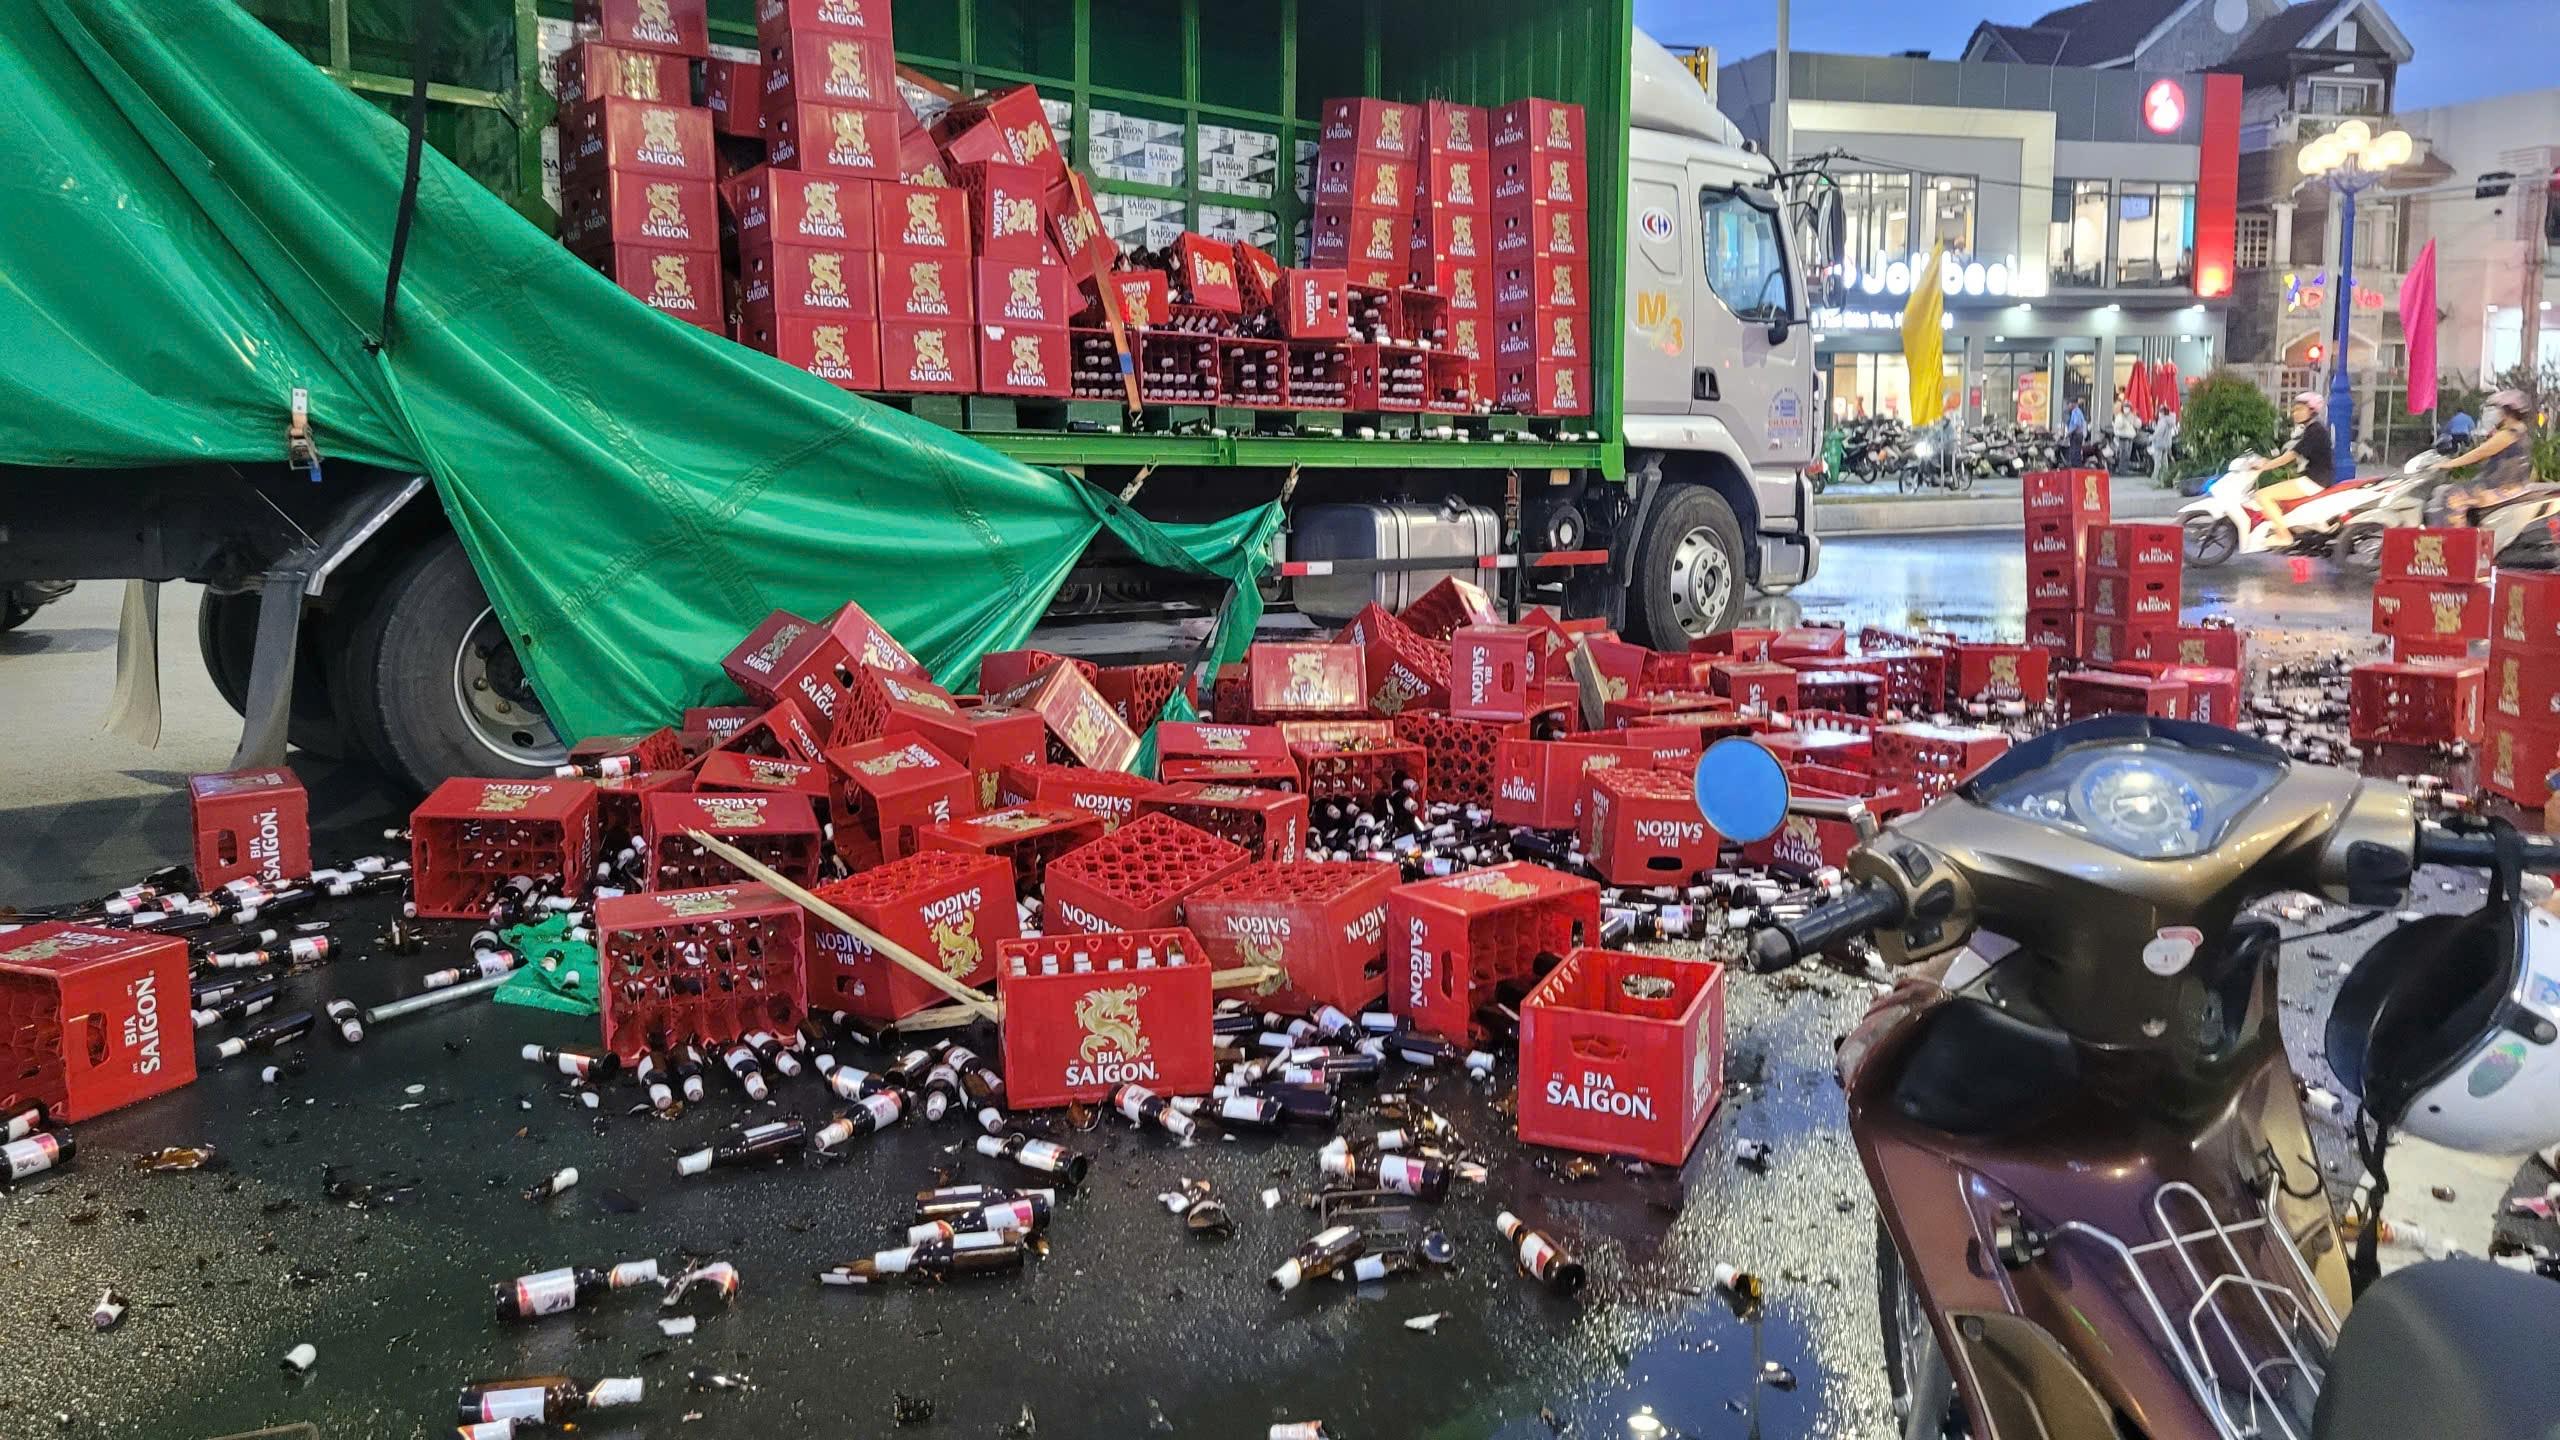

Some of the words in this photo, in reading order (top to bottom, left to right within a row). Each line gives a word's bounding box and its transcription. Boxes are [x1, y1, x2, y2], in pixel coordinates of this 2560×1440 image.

[818, 11, 864, 27] SAIGON
[632, 26, 679, 44] SAIGON
[825, 83, 869, 99] SAIGON
[1326, 128, 1351, 139] SAIGON
[1495, 132, 1524, 146] SAIGON
[1005, 127, 1026, 166] SAIGO
[1376, 138, 1404, 152] SAIGON
[638, 150, 687, 167] SAIGON
[772, 143, 794, 164] SAIGON
[829, 152, 874, 168] SAIGON
[1149, 152, 1178, 162] SAIGON
[1216, 161, 1244, 171] SAIGON
[1322, 183, 1348, 194] SAIGON
[1496, 184, 1525, 198] SAIGON
[993, 189, 1004, 238] SAIGON
[1127, 201, 1157, 211] SAIGON
[743, 212, 766, 230] SAIGON
[641, 223, 690, 240] SAIGON
[799, 222, 845, 238] SAIGON
[1057, 214, 1078, 257] SAIGON
[903, 233, 945, 247] SAIGON
[1317, 237, 1343, 248] SAIGON
[1498, 237, 1527, 250] SAIGON
[1366, 248, 1394, 261] SAIGON
[746, 285, 769, 303] SAIGON
[804, 294, 850, 309] SAIGON
[1500, 290, 1528, 302] SAIGON
[647, 295, 696, 311] SAIGON
[907, 302, 948, 315] SAIGON
[1305, 280, 1316, 328] SAIGON
[1005, 306, 1044, 320] SAIGON
[1501, 341, 1529, 353] SAIGON
[808, 366, 853, 380] SAIGON
[910, 371, 952, 382] SAIGON
[1007, 373, 1046, 386] SAIGON
[1502, 392, 1530, 404] SAIGON
[2031, 495, 2064, 507] SAIGON
[2033, 541, 2066, 552] SAIGON
[2138, 553, 2173, 564] SAIGON
[2406, 565, 2448, 577] SAIGON
[2035, 586, 2068, 598] SAIGON
[2136, 602, 2171, 612] SAIGON
[867, 628, 908, 670] SAIGON
[743, 654, 774, 675] SAIGON
[1391, 662, 1430, 697] SAIGON
[1472, 646, 1485, 706] SAIGON
[1485, 666, 1493, 685] BIA
[799, 675, 835, 720] SAIGO
[821, 683, 837, 700] BIA
[749, 758, 812, 774] SAIGON
[484, 783, 553, 794] SAIGON
[1501, 783, 1536, 802] SAIGON
[696, 797, 767, 806] SAIGON
[1072, 792, 1133, 813] SAIGON
[1637, 819, 1704, 839] SAIGON
[249, 836, 261, 859] BIA
[260, 812, 281, 881] SAIGON
[1773, 844, 1824, 868] SAIGON
[923, 887, 982, 923] SAIGON
[945, 910, 964, 926] BIA
[1226, 916, 1291, 935] SAIGON
[1346, 902, 1389, 944] AIGON
[1250, 933, 1271, 945] BIA
[1365, 927, 1381, 945] BIA
[837, 953, 855, 966] BIA
[1410, 916, 1424, 1008] SAIGON
[1423, 951, 1432, 980] BIA
[124, 1015, 138, 1047] BIA
[136, 976, 160, 1075] SAIGON
[1097, 1051, 1125, 1064] BIA
[1065, 1061, 1160, 1087] SAIGON
[1583, 1071, 1615, 1090] BIA
[1546, 1081, 1652, 1121] SAIGON
